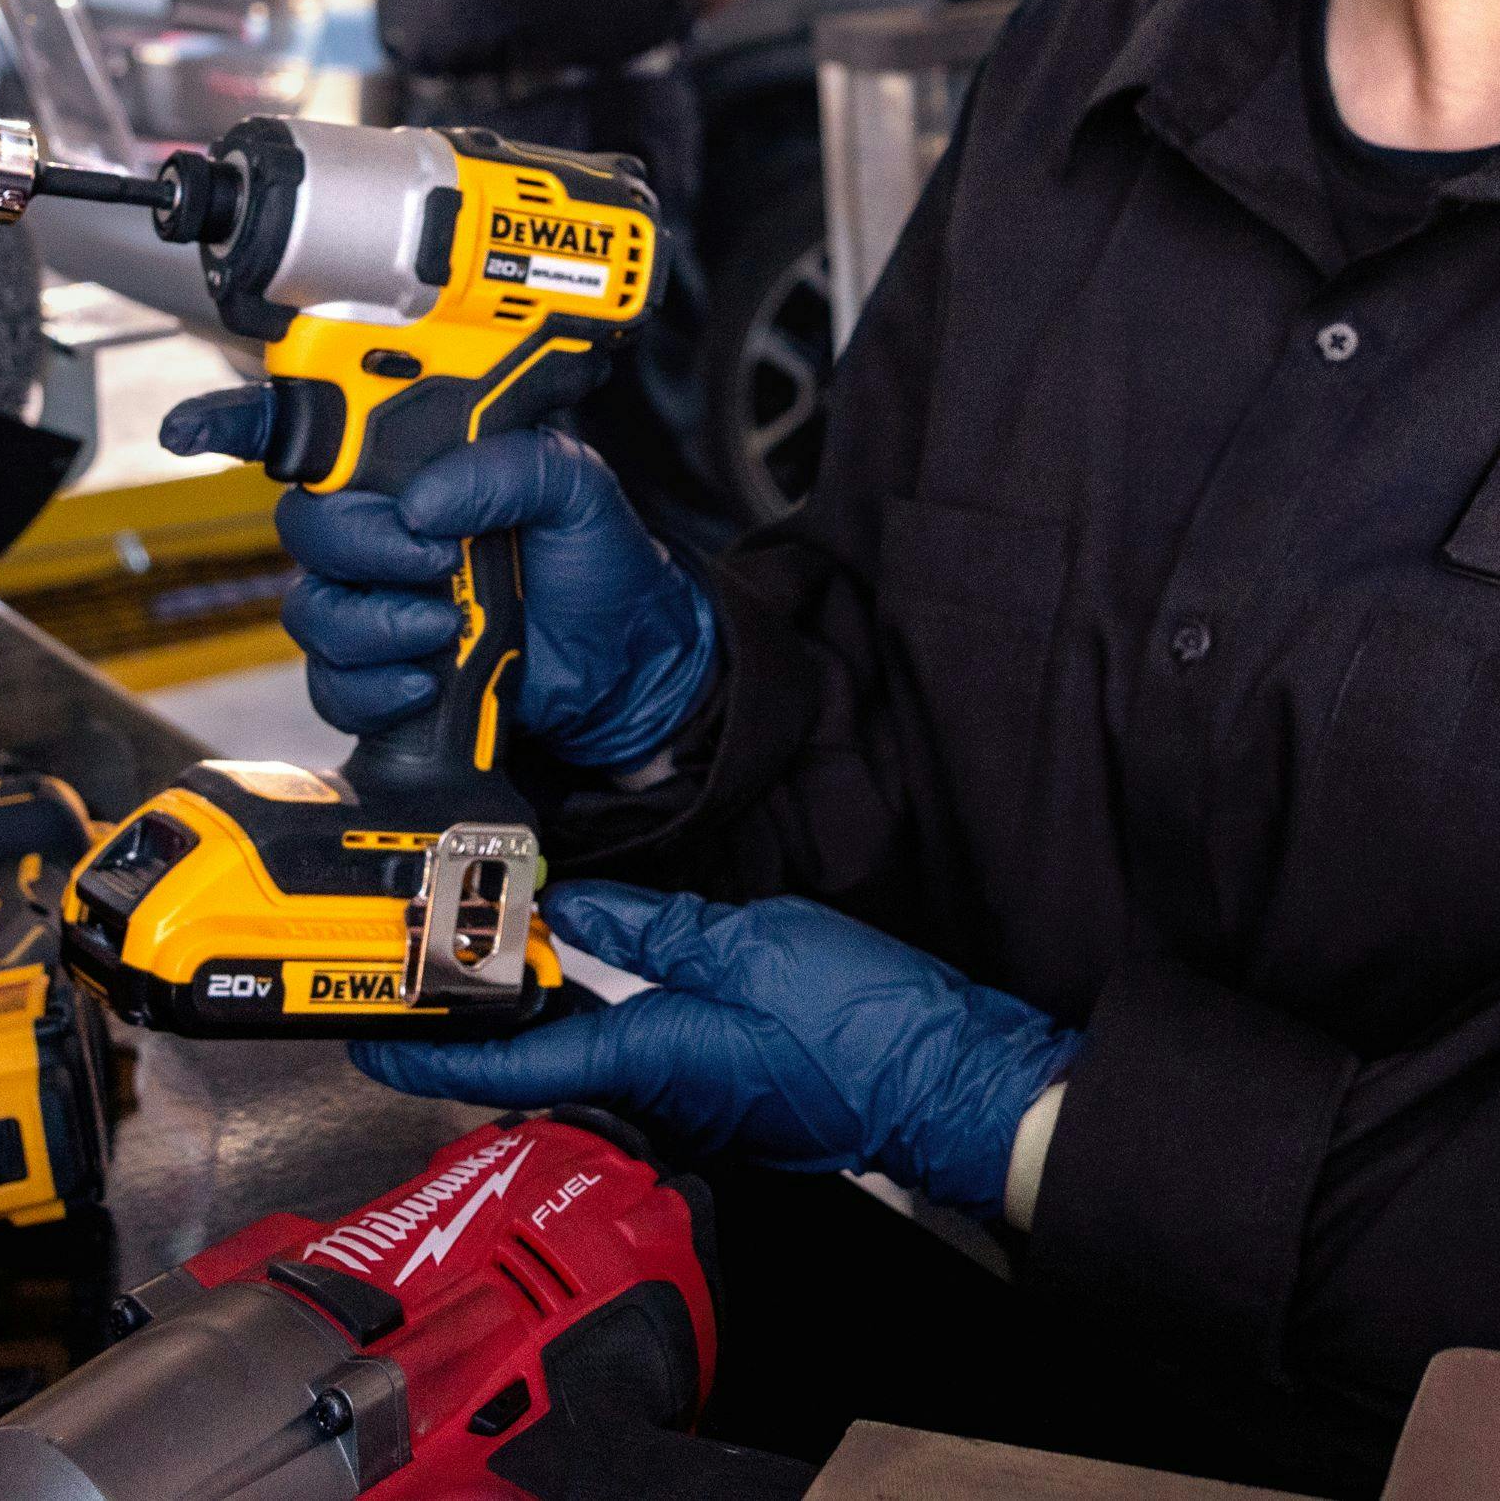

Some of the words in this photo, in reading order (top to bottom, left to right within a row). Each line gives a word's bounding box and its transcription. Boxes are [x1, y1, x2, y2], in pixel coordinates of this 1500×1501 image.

[490, 212, 615, 256] DEWALT
[310, 974, 397, 999] DEWA
[302, 1133, 524, 1275] Milwaukee
[530, 1171, 602, 1230] FUEL
